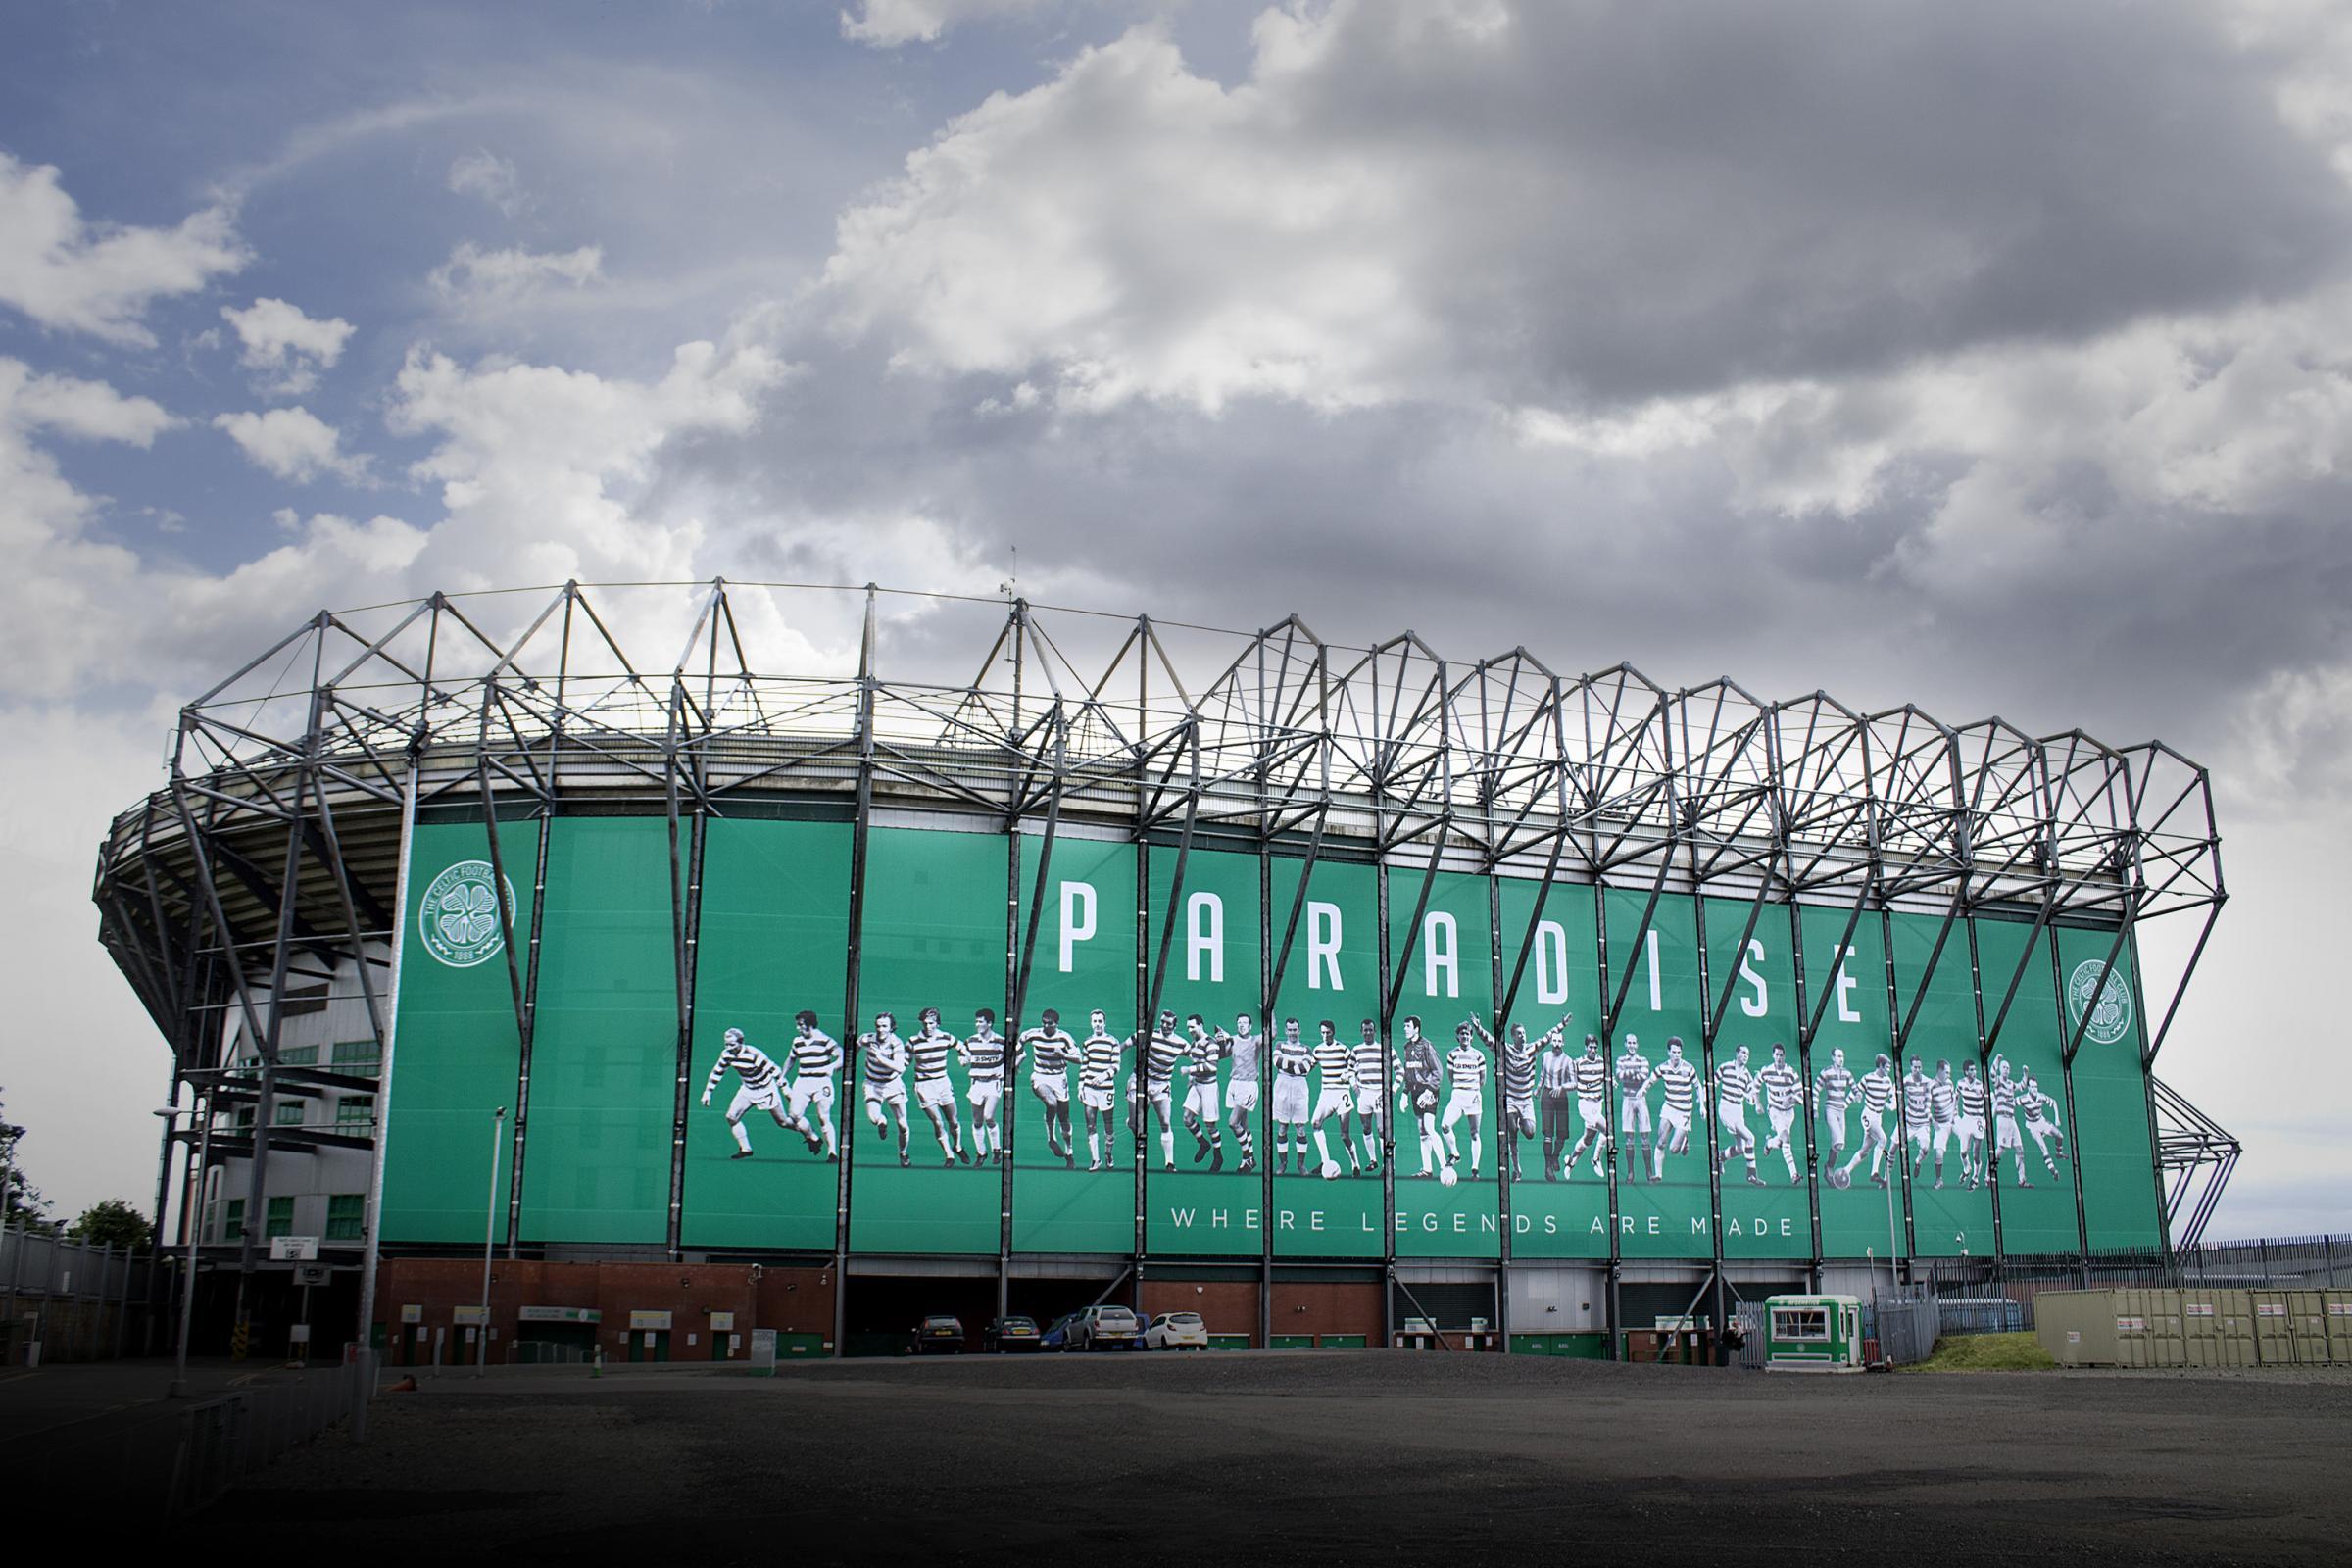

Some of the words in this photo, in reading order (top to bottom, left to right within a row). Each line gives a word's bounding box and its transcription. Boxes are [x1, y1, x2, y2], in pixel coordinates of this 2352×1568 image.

[435, 869, 461, 895] CELTIC
[1058, 880, 1861, 1023] PARADISE
[1106, 1093, 1114, 1106] 9
[1342, 1094, 1351, 1108] 2
[1170, 1207, 1325, 1231] WHERE
[1362, 1212, 1557, 1234] LEGENDS
[1590, 1215, 1660, 1235] ARE
[1691, 1216, 1792, 1237] MADE
